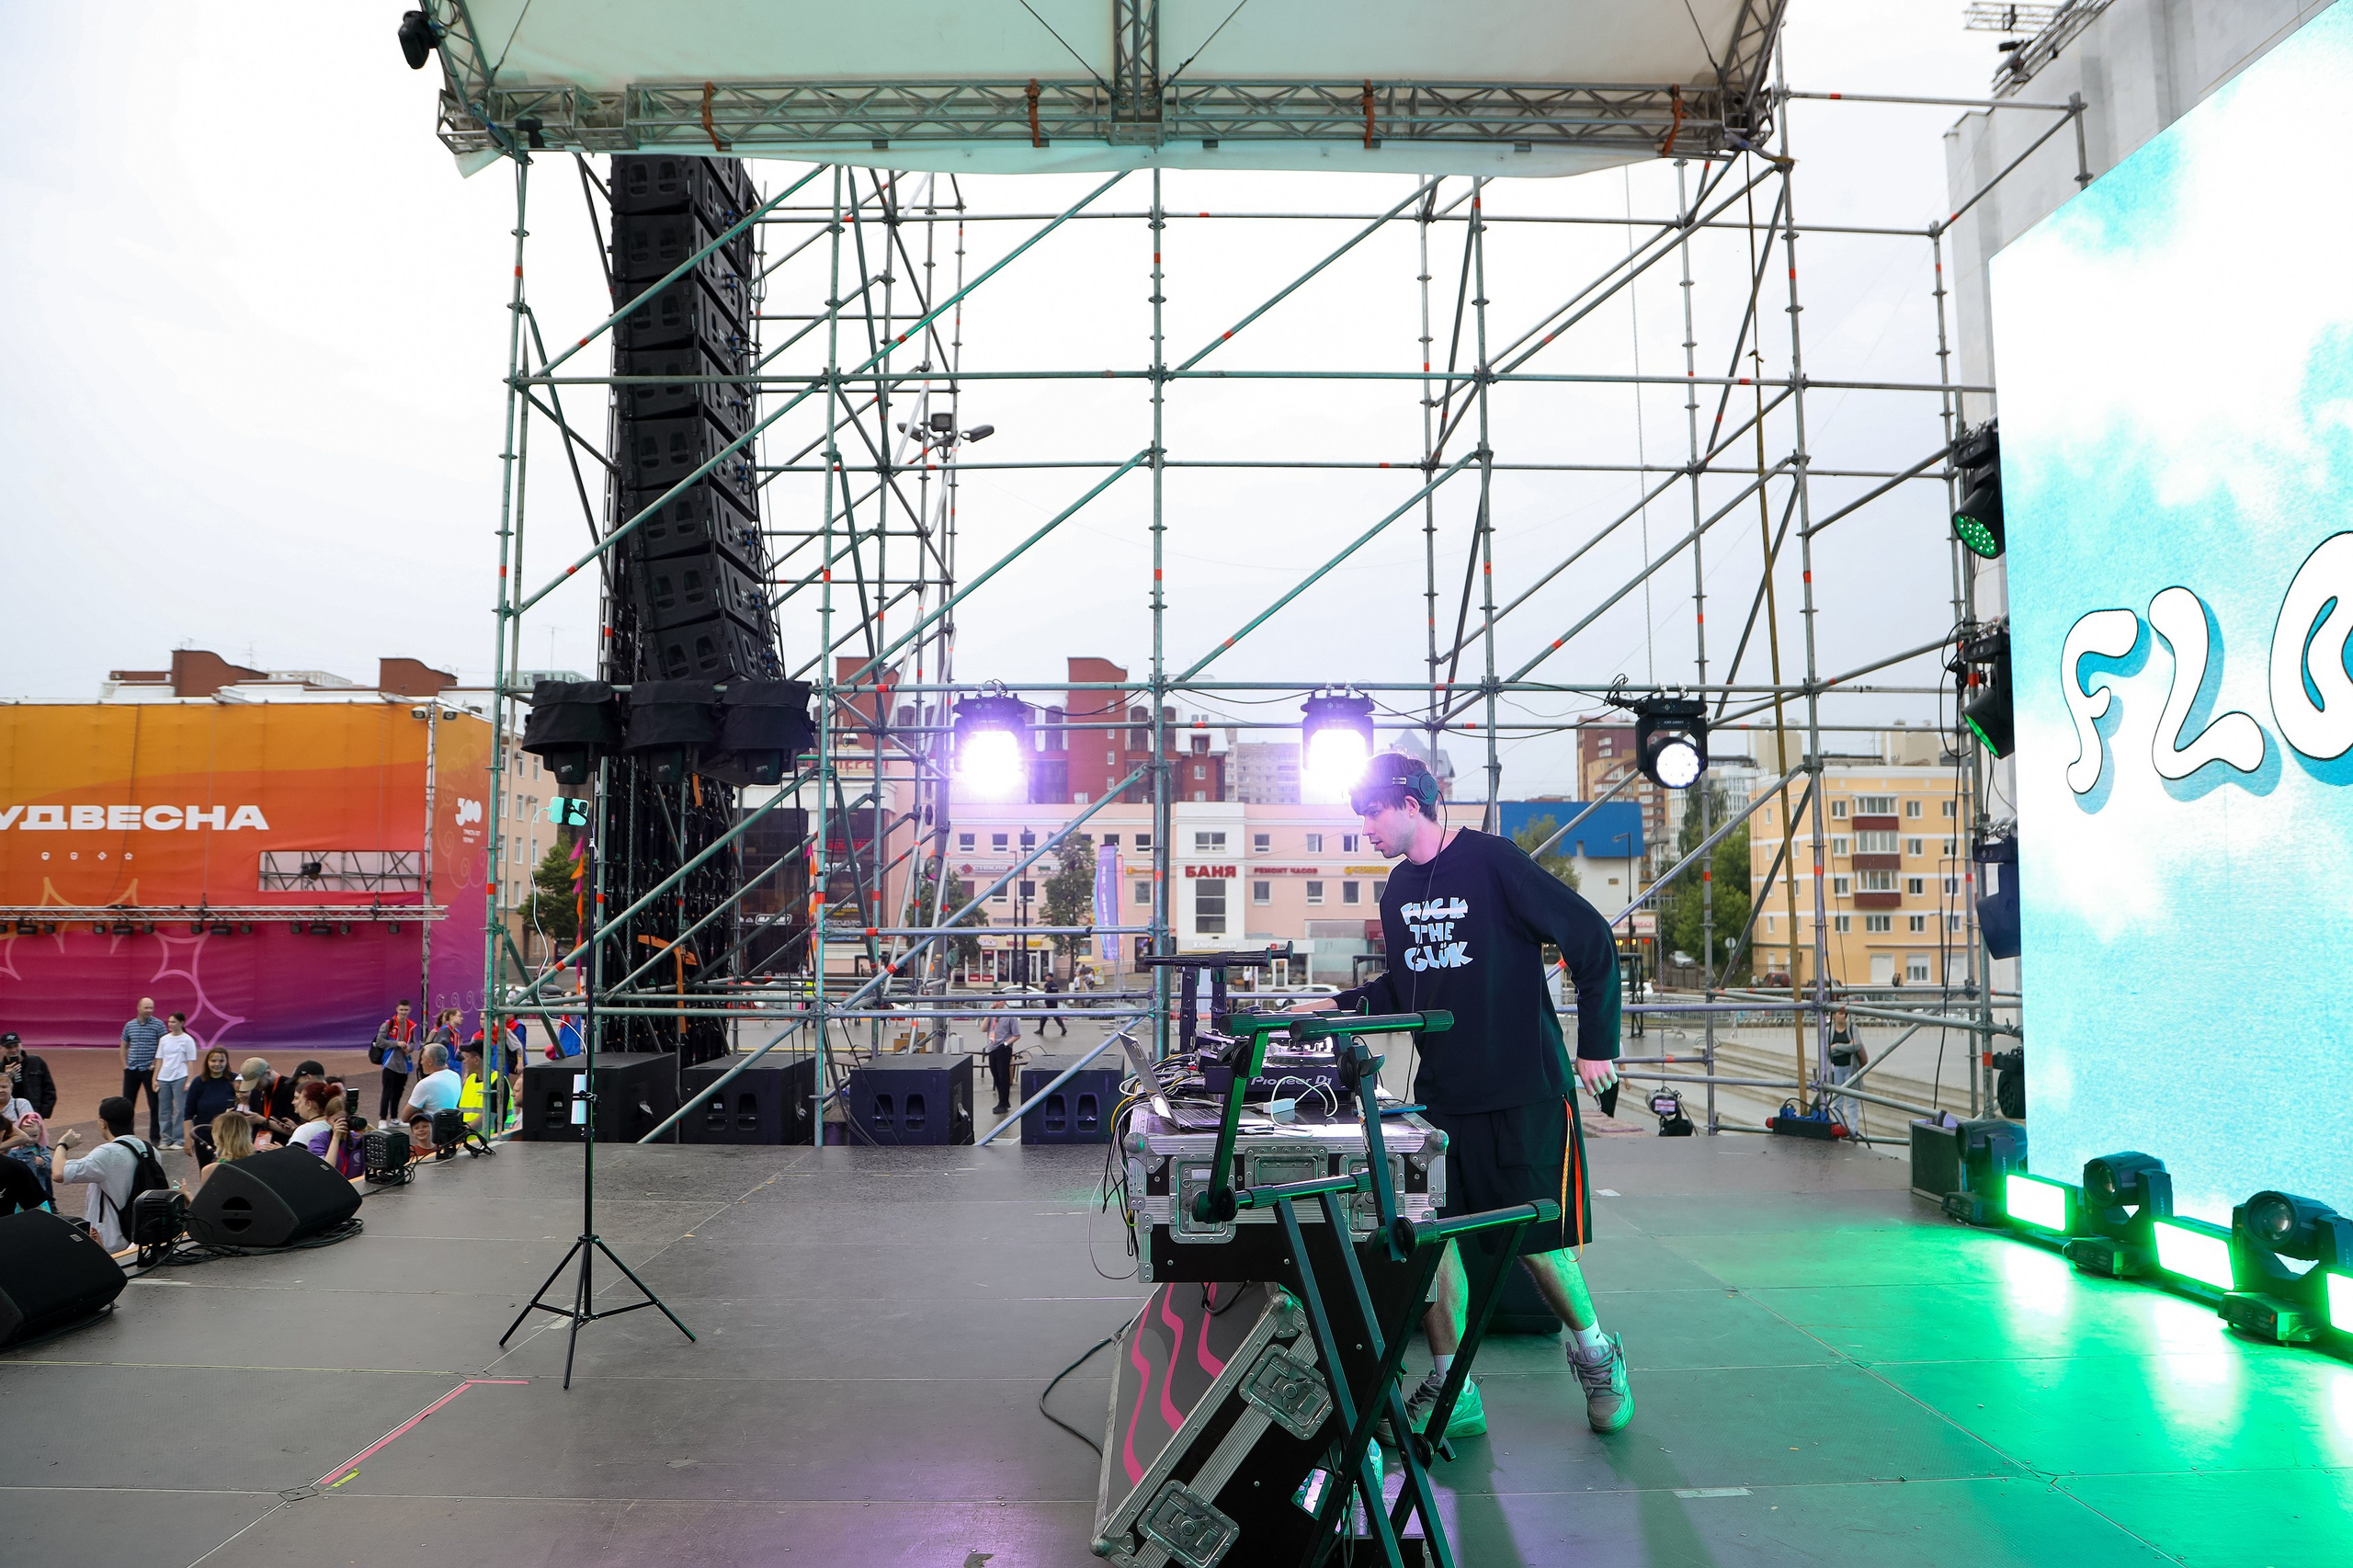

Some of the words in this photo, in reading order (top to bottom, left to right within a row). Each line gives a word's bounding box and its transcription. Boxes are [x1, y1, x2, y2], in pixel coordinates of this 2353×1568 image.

[1185, 865, 1236, 878] БАНЯ
[1409, 921, 1454, 944] THE
[1404, 941, 1473, 971] GLÜK
